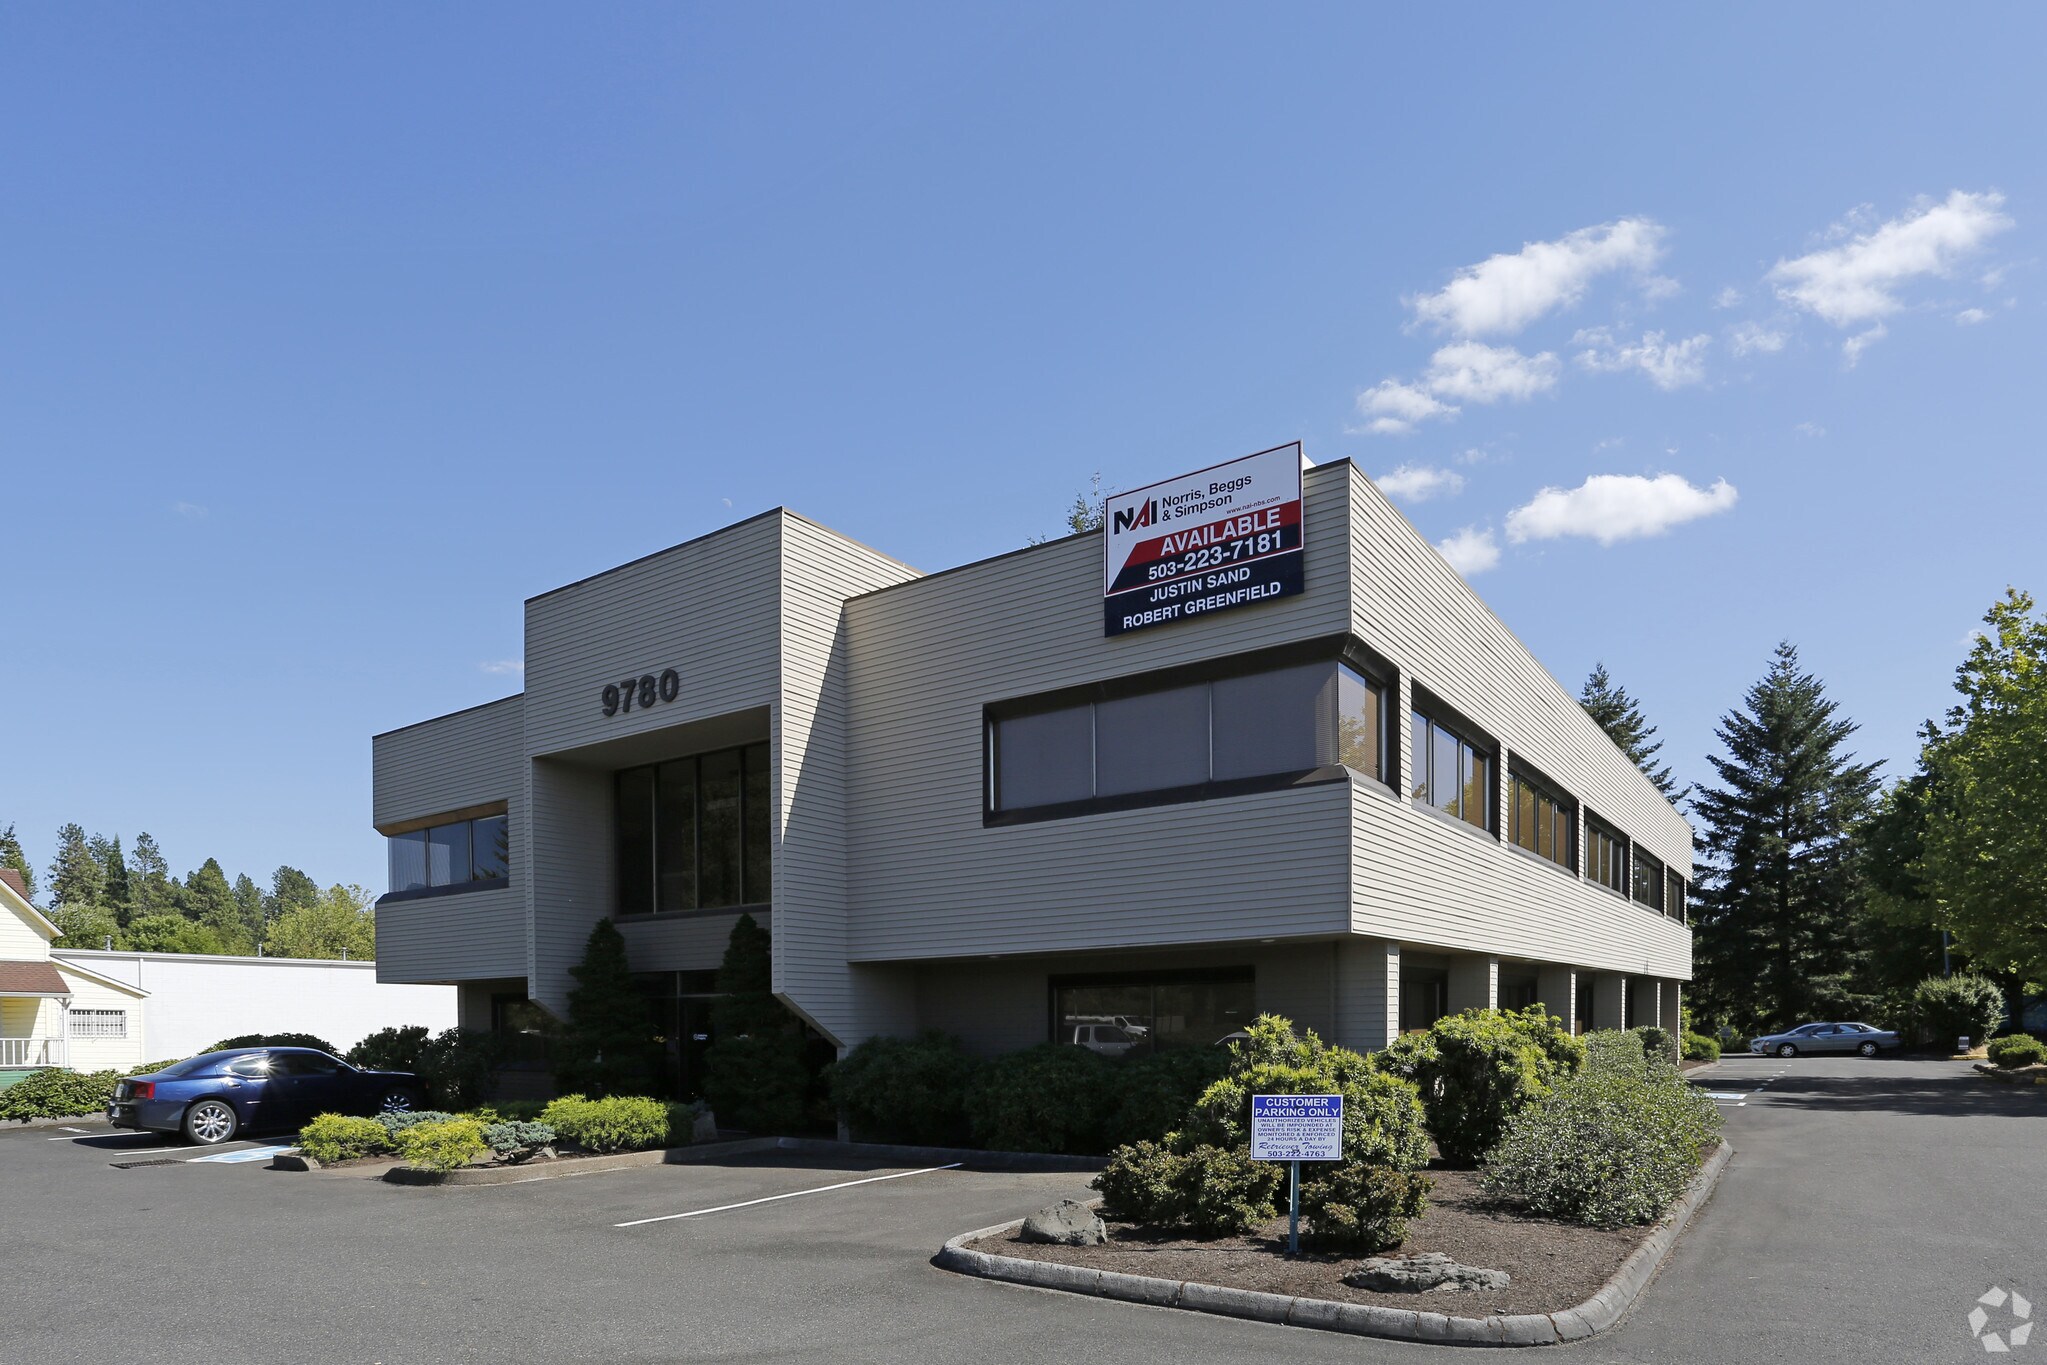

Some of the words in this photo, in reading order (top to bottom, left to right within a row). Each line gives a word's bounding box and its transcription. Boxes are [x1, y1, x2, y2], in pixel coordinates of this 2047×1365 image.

[1162, 489, 1205, 509] Norris,
[1209, 474, 1252, 495] Beggs
[1162, 511, 1171, 521] &
[1175, 494, 1232, 518] Simpson
[1113, 496, 1158, 535] NAI
[1160, 507, 1281, 556] AVAILABLE
[1148, 530, 1281, 580] 503-223-7181
[1150, 578, 1202, 602] JUSTIN
[1207, 567, 1251, 588] SAND
[1123, 604, 1181, 629] ROBERT
[1184, 581, 1281, 614] GREENFIELD
[601, 667, 680, 717] 9780
[1255, 1108, 1306, 1117] PARKING
[1308, 1108, 1339, 1117] ONLY
[1265, 1098, 1329, 1107] CUSTOMER
[1258, 1142, 1299, 1150] Retriever
[1301, 1142, 1333, 1151] Towing
